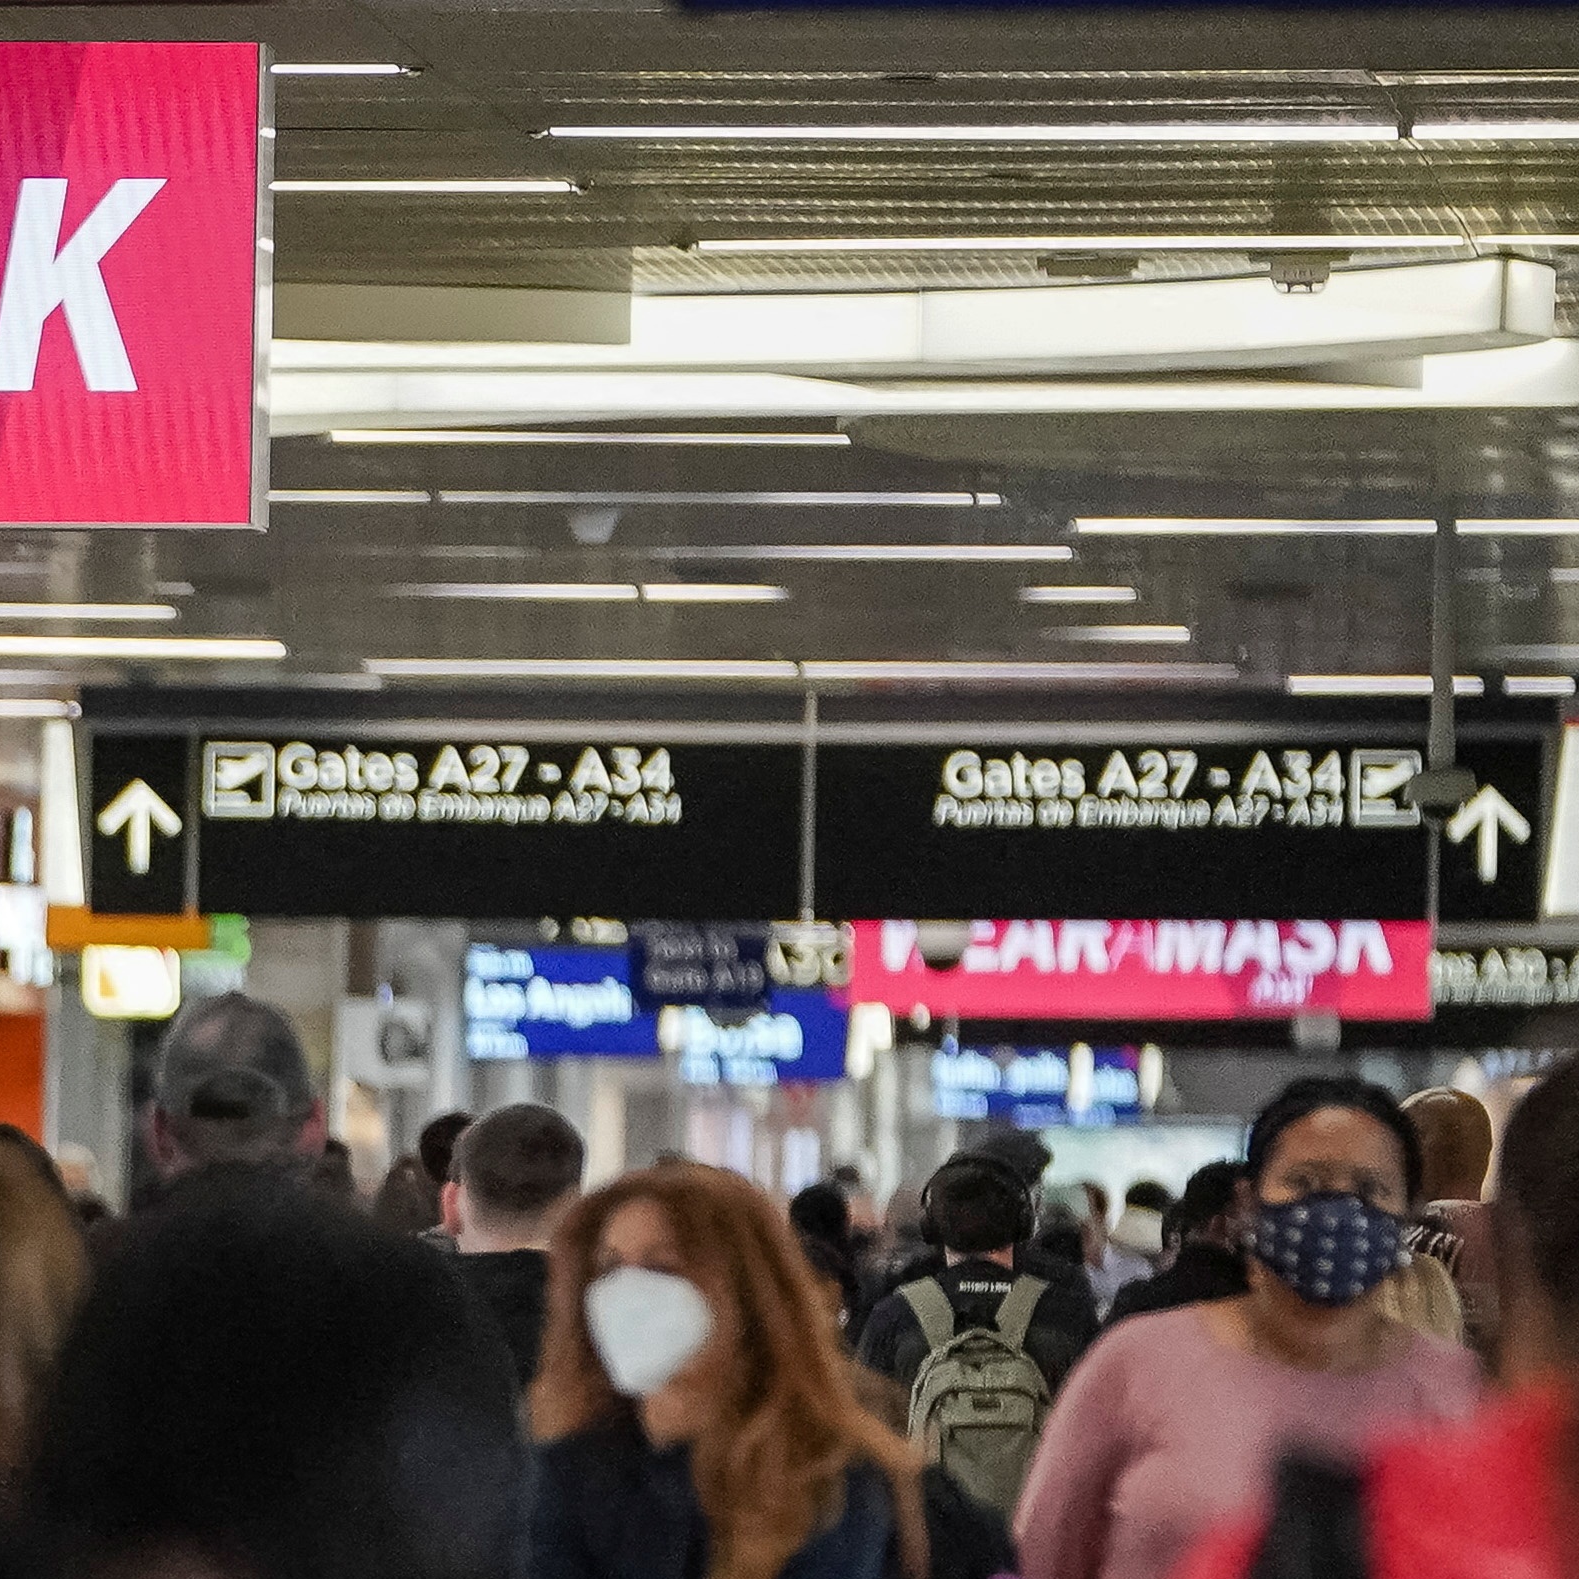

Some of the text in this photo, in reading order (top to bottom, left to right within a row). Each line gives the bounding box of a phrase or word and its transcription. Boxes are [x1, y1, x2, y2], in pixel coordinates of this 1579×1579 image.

[277, 741, 419, 792] Gates
[429, 745, 530, 792] A27
[569, 745, 674, 793] A34
[943, 749, 1086, 799] Gates
[1097, 749, 1198, 799] A27
[1241, 750, 1344, 799] A34
